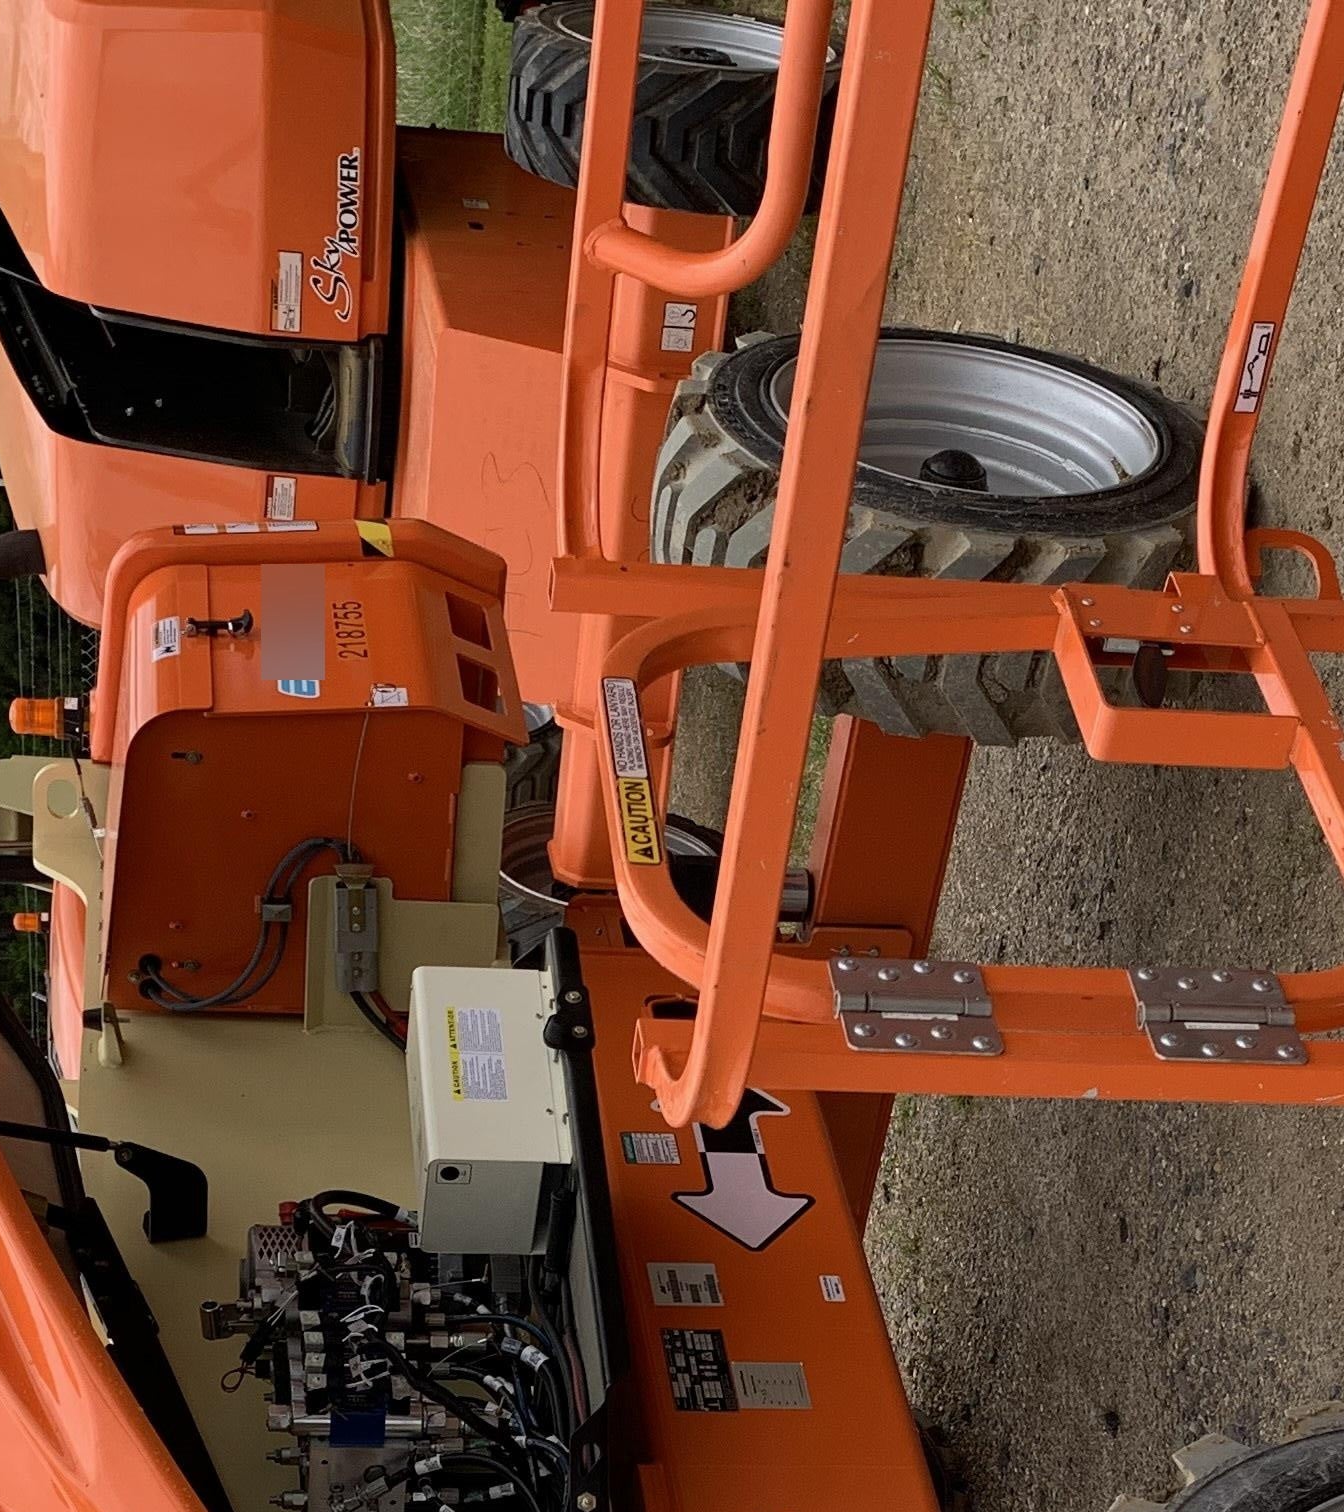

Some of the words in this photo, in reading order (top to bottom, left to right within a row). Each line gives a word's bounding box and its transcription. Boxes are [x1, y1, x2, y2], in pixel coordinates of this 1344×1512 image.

[332, 601, 368, 658] 218755
[606, 683, 621, 717] LANYARD
[616, 685, 626, 704] RESULT
[611, 719, 622, 730] OR
[621, 718, 630, 731] HERE
[613, 732, 625, 758] HANDS
[617, 760, 627, 772] NO
[623, 781, 652, 844] CAUTION
[447, 1010, 456, 1042] ATTENTION
[452, 1061, 460, 1088] CAUTION
